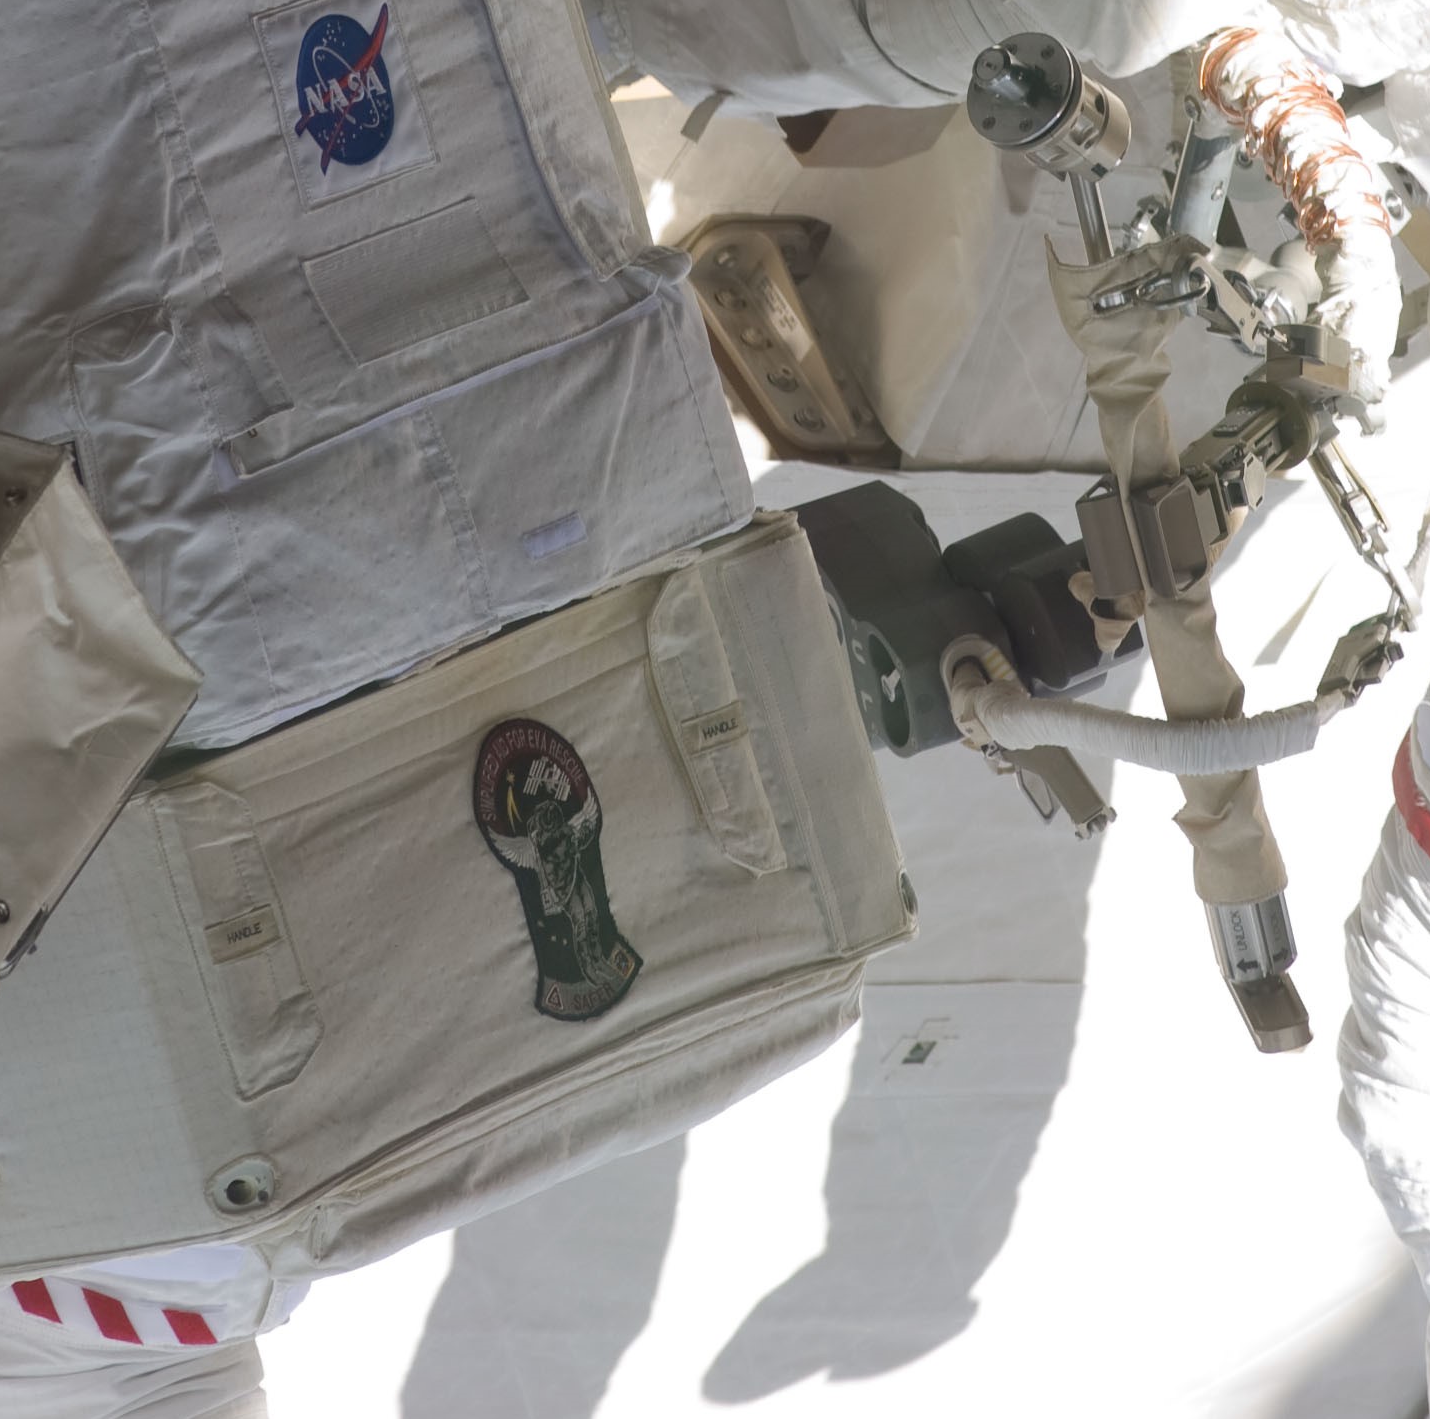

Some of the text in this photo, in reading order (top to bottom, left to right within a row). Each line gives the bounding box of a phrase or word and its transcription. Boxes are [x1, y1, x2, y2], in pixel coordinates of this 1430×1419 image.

[304, 66, 386, 117] NASA
[701, 717, 739, 741] HANDLE
[506, 728, 526, 750] FOR
[527, 728, 547, 752] EVA
[548, 738, 583, 786] RESCUE
[227, 920, 263, 945] HANDLE
[1232, 910, 1248, 952] UNLOCK
[572, 981, 615, 1011] SAFER
